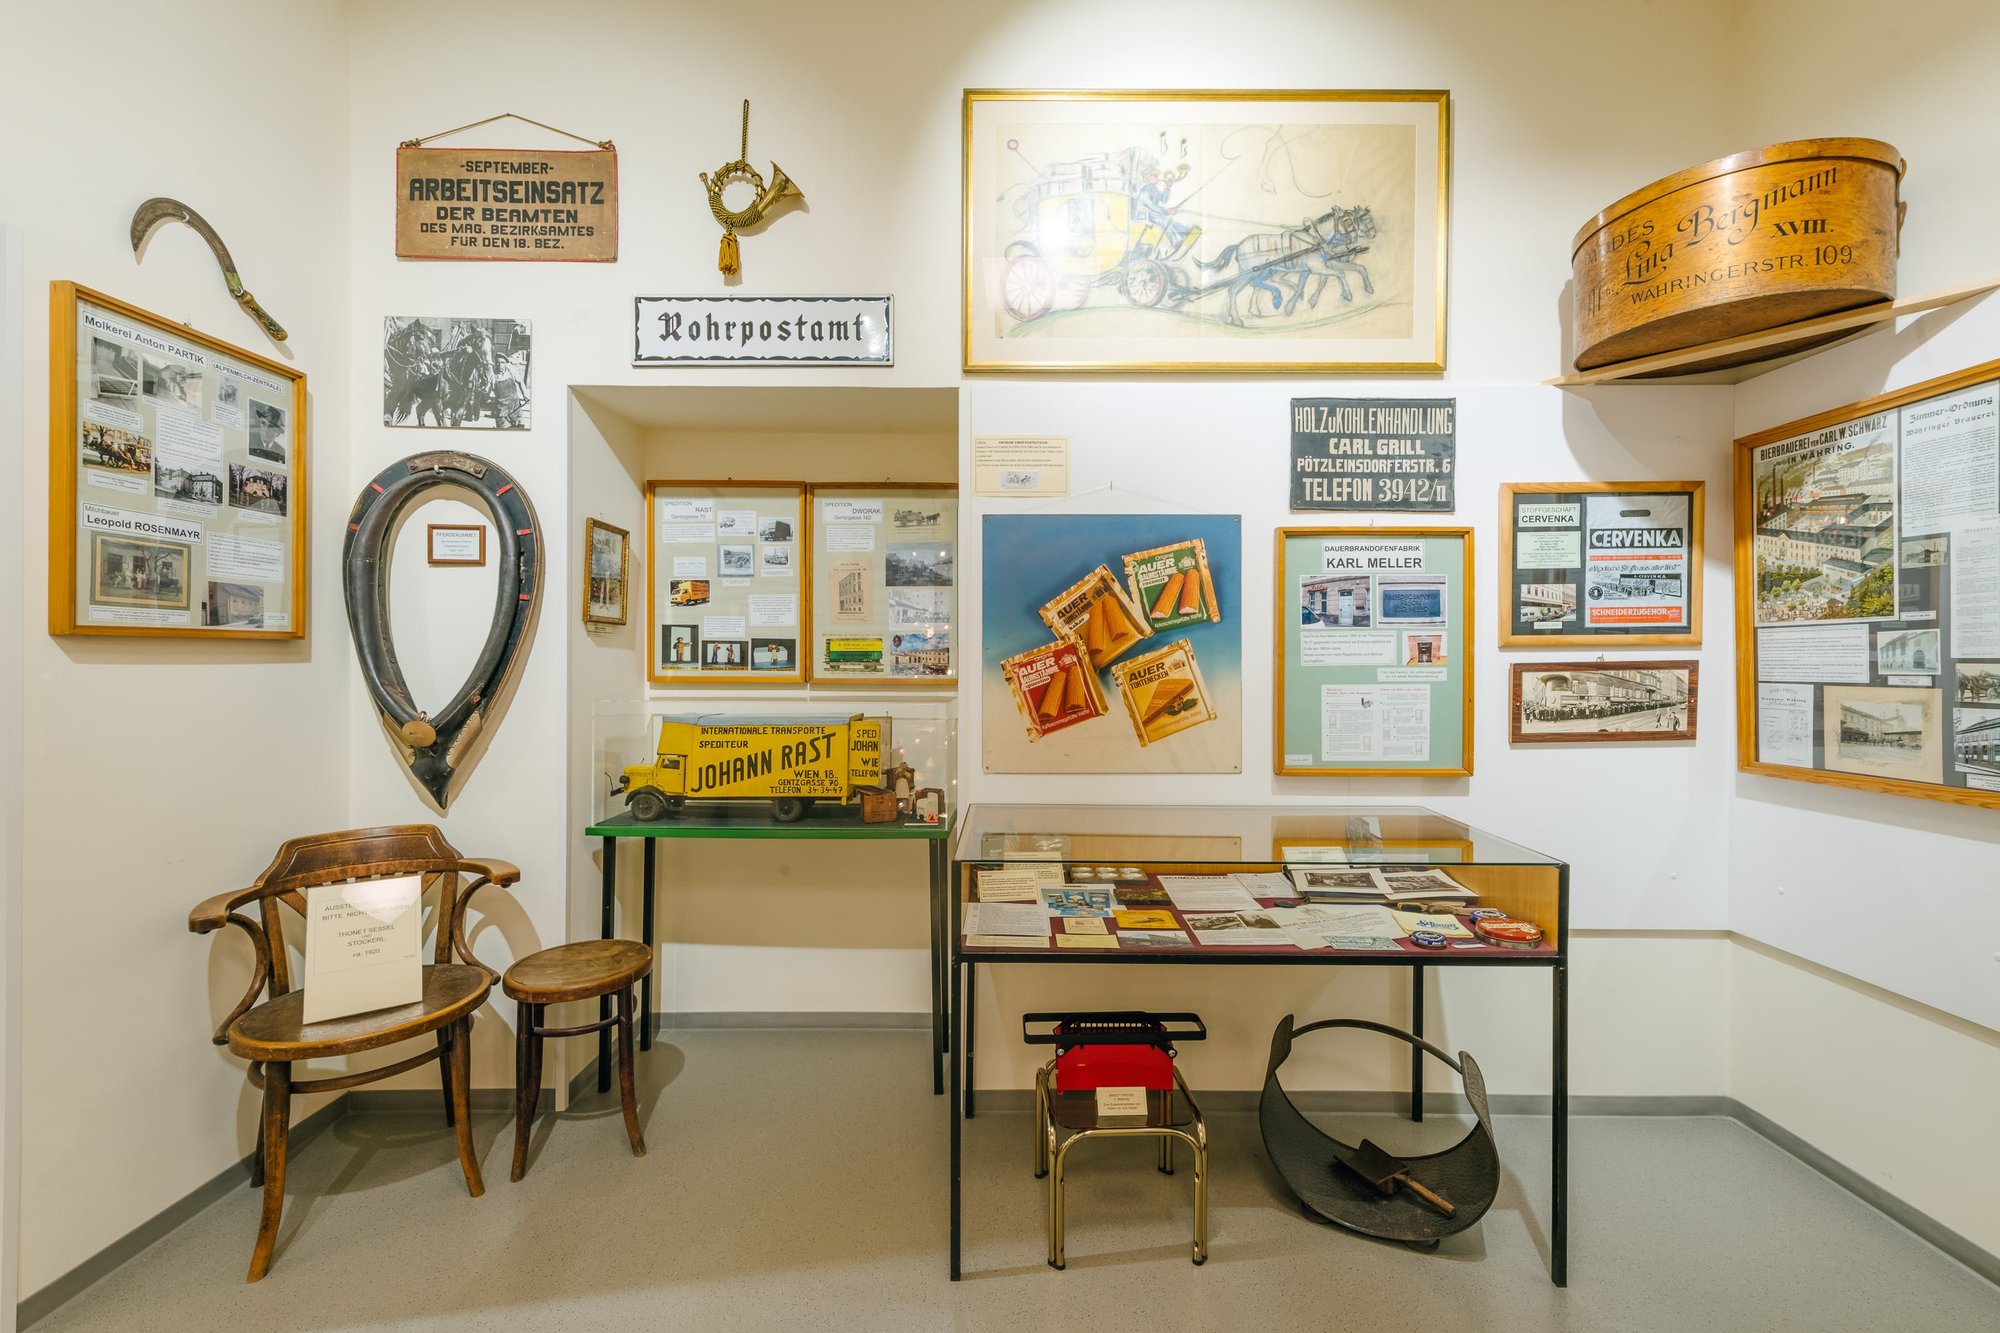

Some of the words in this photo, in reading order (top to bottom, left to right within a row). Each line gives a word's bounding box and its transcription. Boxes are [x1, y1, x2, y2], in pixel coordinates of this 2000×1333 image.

[409, 178, 604, 205] ARBEITSEINSATZ
[436, 206, 475, 221] DER
[481, 208, 578, 223] BEAMTEN
[1677, 166, 1837, 248] Bergmann
[420, 222, 447, 233] DES
[452, 223, 486, 235] MAG.
[490, 225, 594, 237] BEZIRKSAMTES
[451, 235, 477, 247] FÜR
[482, 237, 510, 248] DEN
[513, 238, 531, 249] 18.
[534, 238, 565, 249] BEZ.
[1814, 244, 1853, 267] 109
[657, 311, 866, 348] Rohrpostamt
[84, 313, 132, 340] Molkerei
[135, 332, 165, 352] Anton
[168, 344, 205, 366] PARTIK
[1329, 437, 1374, 455] CARL
[1376, 438, 1425, 455] GRILL
[1760, 437, 1810, 461] BIERBRAUEREI
[1819, 429, 1838, 446] CARL
[1838, 426, 1848, 440] W.
[1848, 415, 1888, 437] SCHWARZ
[1787, 454, 1797, 465] IN
[1799, 441, 1855, 461] WÄHRING.
[1296, 455, 1439, 473] PÖTZLEINSDORFERSTR.
[1442, 458, 1451, 473] 6
[1302, 477, 1372, 502] TELEFON
[87, 514, 131, 531] Leopold
[134, 522, 201, 541] ROSENMAYR
[1521, 515, 1575, 523] CERVENKA
[1591, 529, 1682, 549] CERVENKA
[1139, 558, 1176, 573] AUER
[1326, 557, 1363, 569] KARL
[1367, 557, 1422, 569] MELLER
[1057, 592, 1088, 619] AUER
[1019, 657, 1056, 677] AUER
[1128, 661, 1165, 683] AUER
[1129, 670, 1169, 690] TORTENECKEN
[701, 726, 768, 735] INTERNATIONALE
[771, 726, 826, 735] TRANSPORTE
[856, 729, 877, 739] SPED
[699, 740, 749, 749] SPEDITEUR
[851, 740, 879, 752] JOHAN
[690, 749, 772, 793] JOHANN
[781, 732, 837, 770] RAST
[861, 757, 879, 767] WIE
[851, 769, 879, 778] TELEFON
[769, 786, 802, 794] TELEFON
[807, 786, 843, 794] 34-34-47
[778, 779, 826, 787] GENTZGASSE
[828, 779, 839, 787] 70
[322, 913, 342, 921] BITTE
[338, 928, 367, 938] THONET
[368, 924, 395, 933] SESSEL
[347, 936, 385, 947] STOCKERL
[364, 948, 381, 956] 1920
